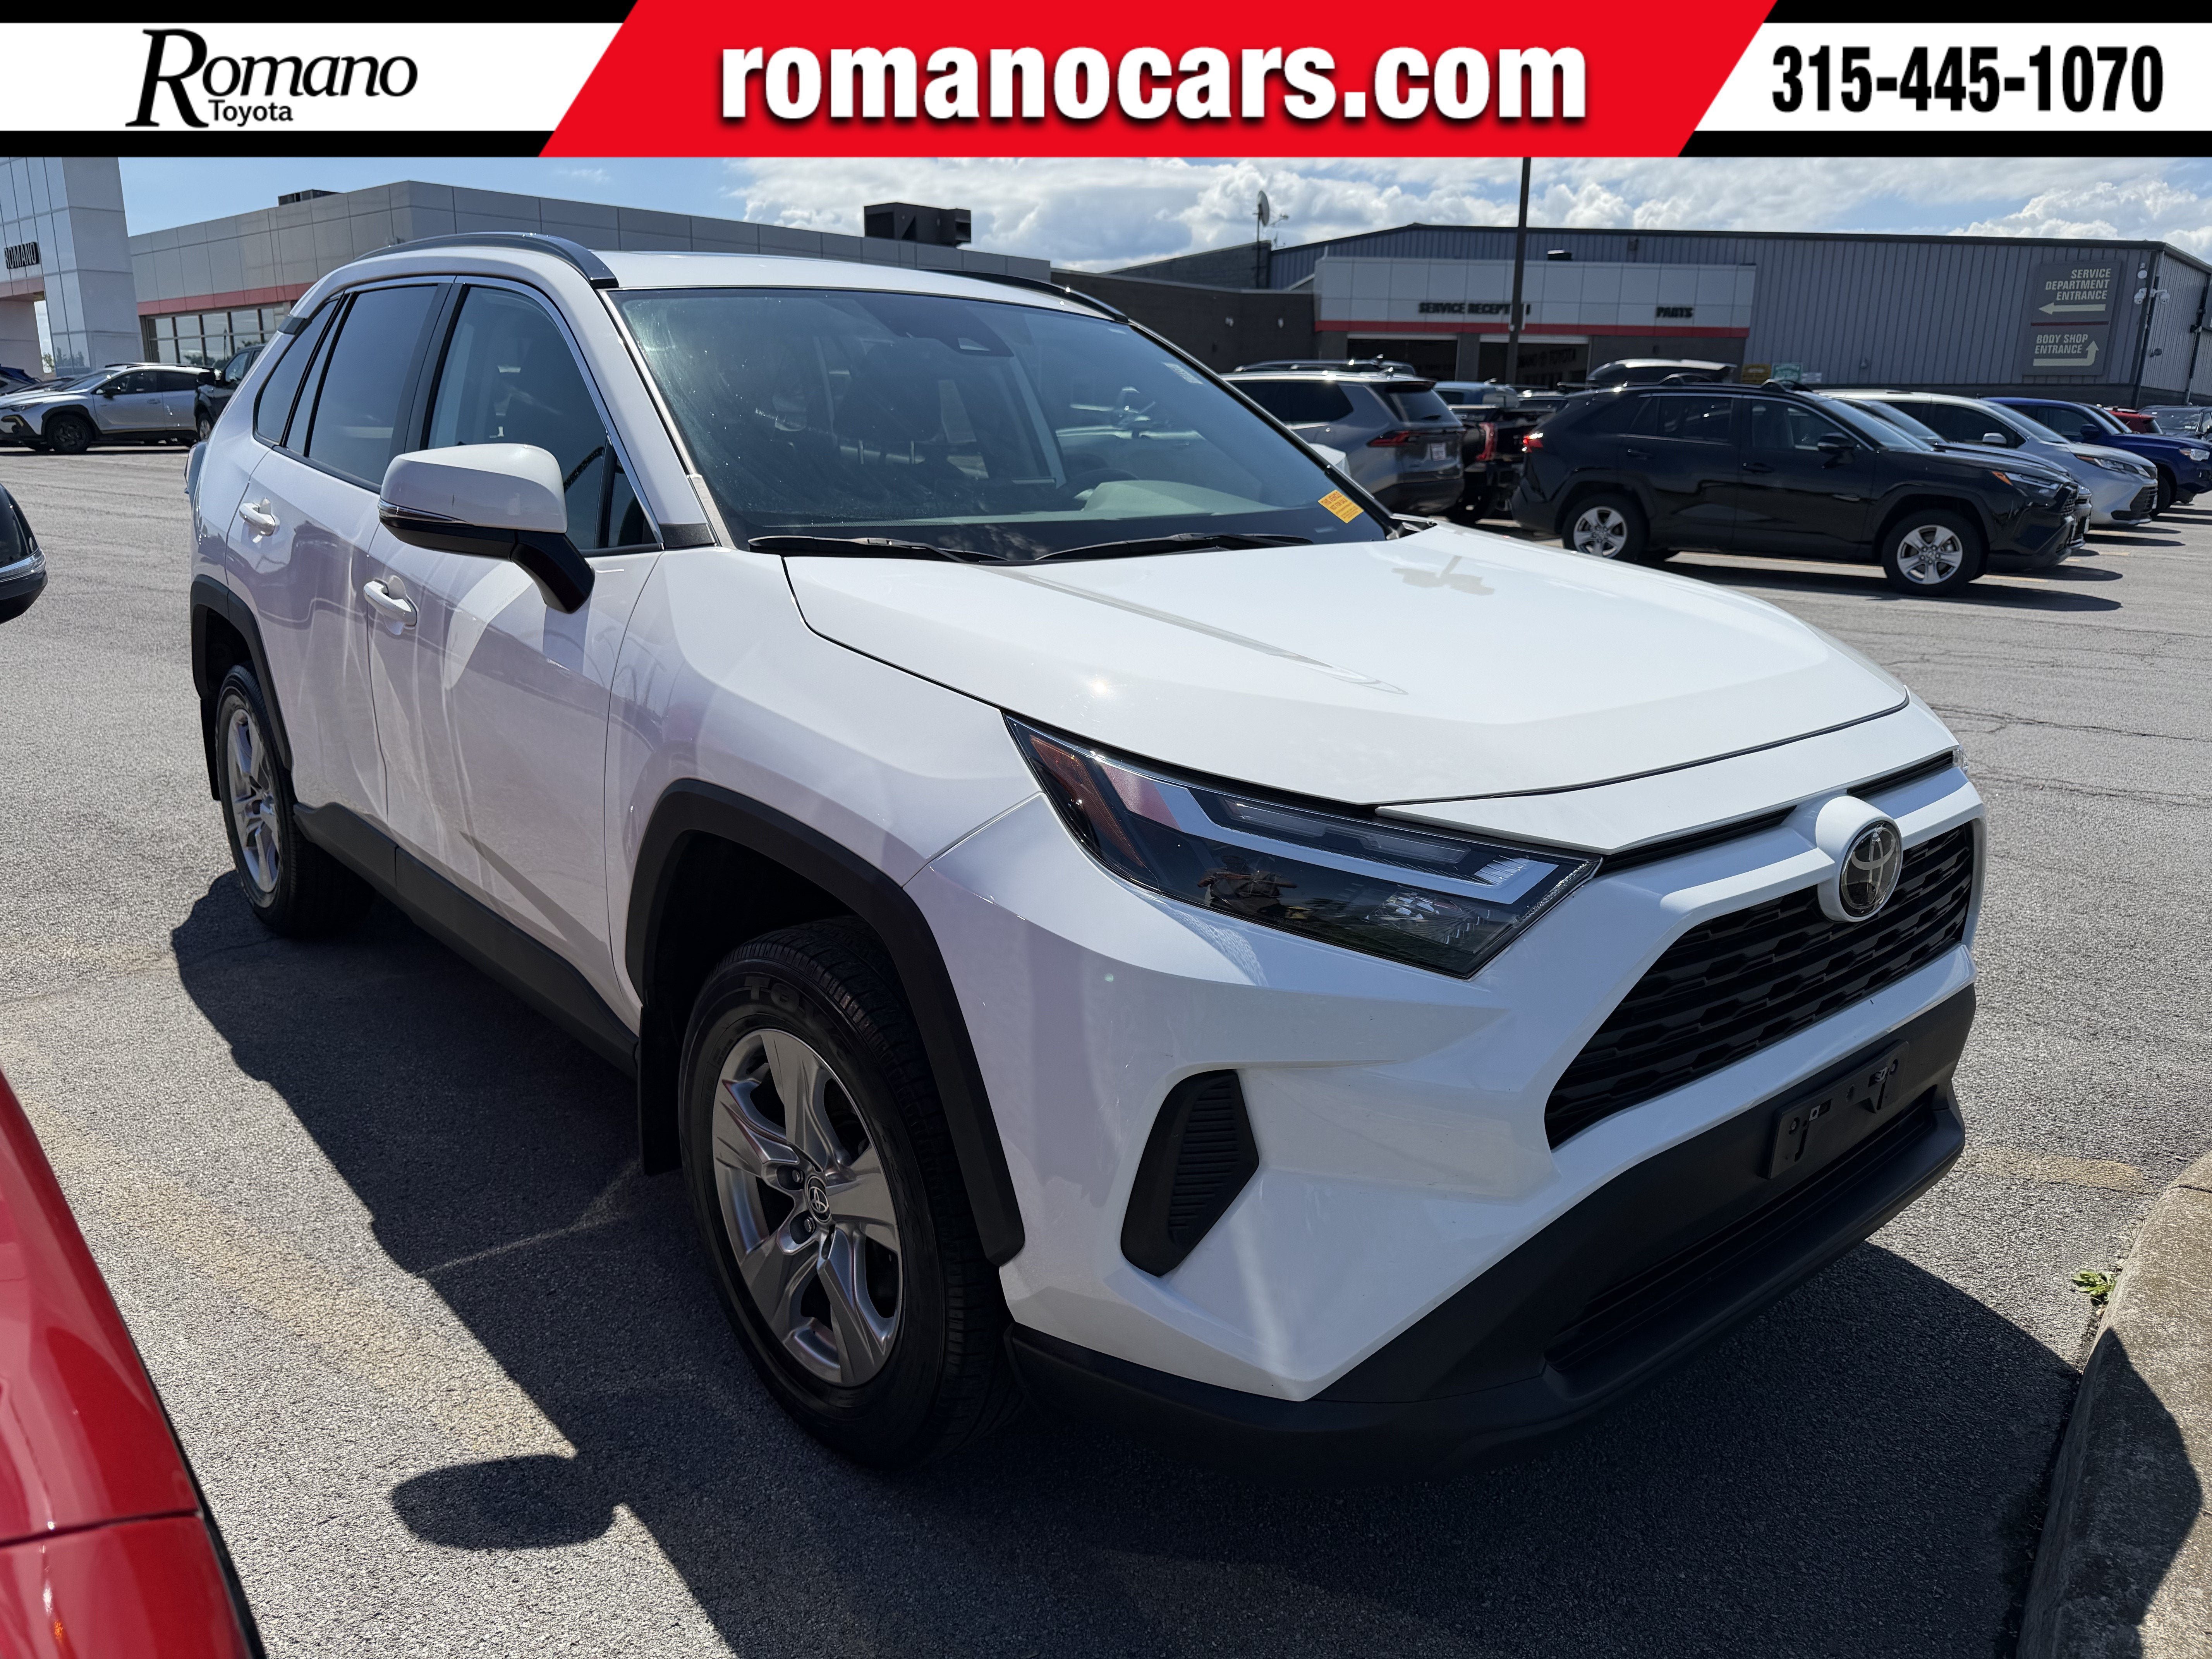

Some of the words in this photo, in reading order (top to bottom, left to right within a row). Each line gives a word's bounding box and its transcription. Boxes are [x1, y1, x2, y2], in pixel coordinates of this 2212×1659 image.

[4, 242, 38, 269] ROMANO
[2071, 268, 2111, 279] SERVICE
[2045, 279, 2110, 290] DEPARTMENT
[2056, 290, 2107, 301] ENTRANCE
[1419, 302, 1465, 313] SERVICE
[1656, 307, 1693, 318] PARTS
[2036, 334, 2061, 343] BODY
[2063, 334, 2088, 343] SHOP
[2035, 344, 2083, 354] ENTRANCE
